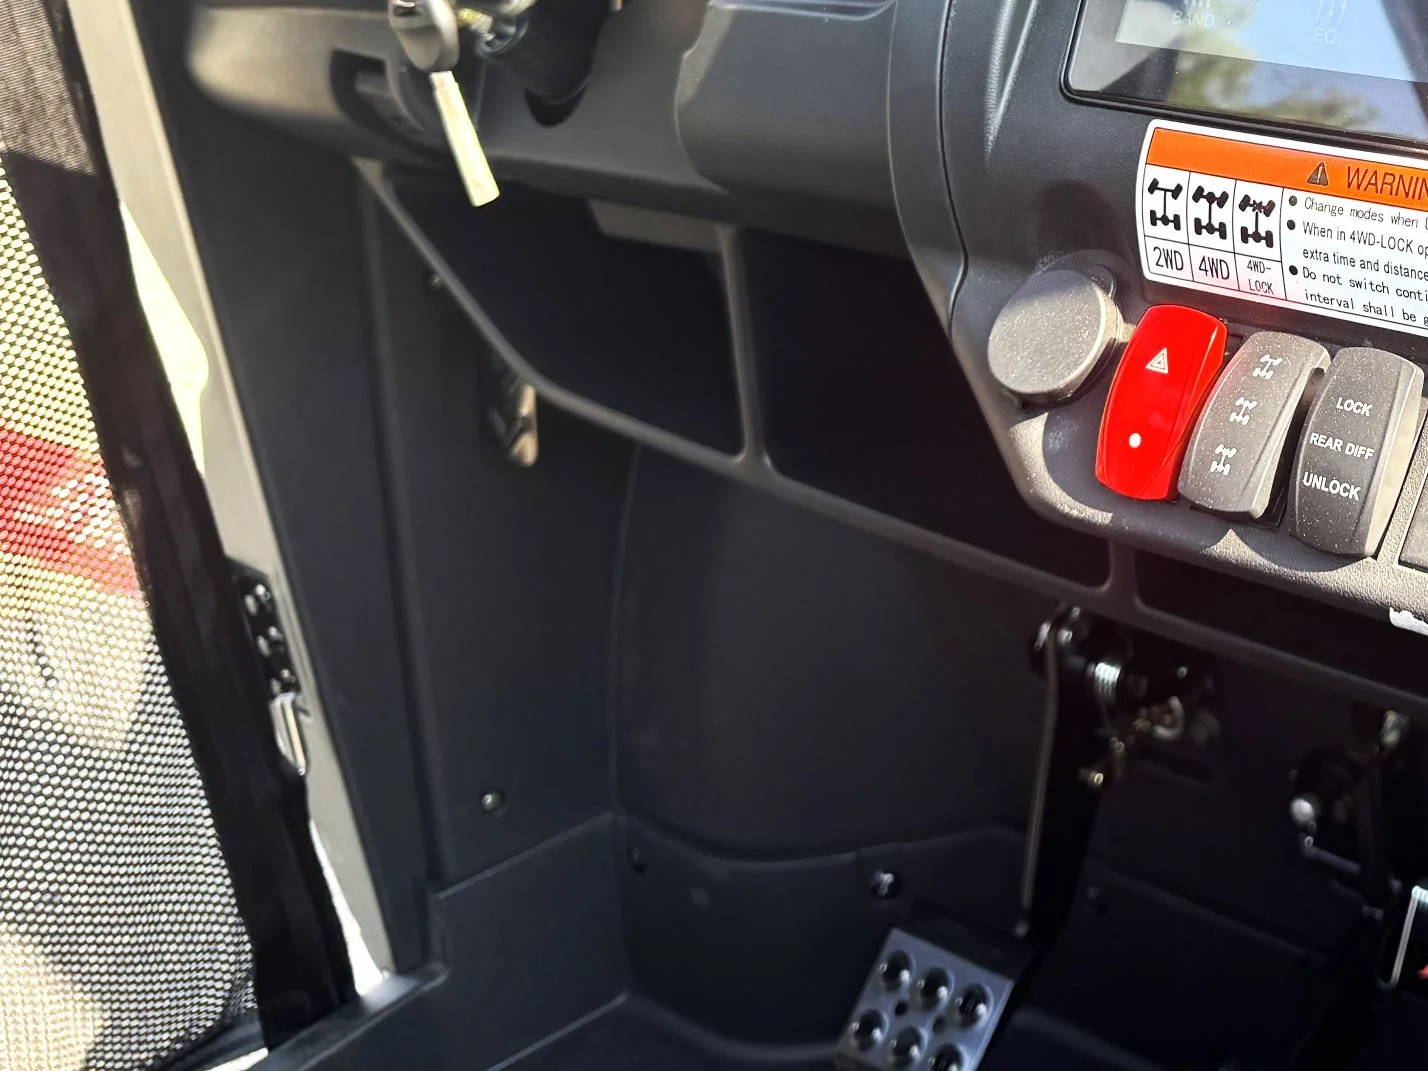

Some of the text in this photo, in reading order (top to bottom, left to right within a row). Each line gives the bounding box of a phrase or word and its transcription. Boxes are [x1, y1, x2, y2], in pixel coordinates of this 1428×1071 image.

[1172, 11, 1216, 29] BAND
[1304, 197, 1344, 217] Change
[1349, 206, 1384, 223] modes
[1390, 212, 1419, 229] when
[1302, 220, 1333, 240] When
[1336, 229, 1346, 242] in
[1349, 230, 1414, 255] 4WD-LOCK
[1153, 246, 1184, 273] 2WD
[1198, 254, 1230, 281] 4WD
[1246, 259, 1272, 275] 4WD-
[1302, 247, 1330, 264] extra
[1332, 252, 1357, 268] time
[1359, 259, 1380, 273] and
[1249, 278, 1274, 296] LOCK
[1302, 266, 1317, 281] Do
[1322, 274, 1343, 287] not
[1349, 277, 1390, 295] switch
[1305, 289, 1355, 311] interval
[1362, 301, 1395, 319] shall
[1402, 309, 1418, 322] be
[1335, 396, 1374, 417] LOCK
[1309, 432, 1375, 461] REAR DIFF
[1302, 471, 1362, 501] UNLOCK
